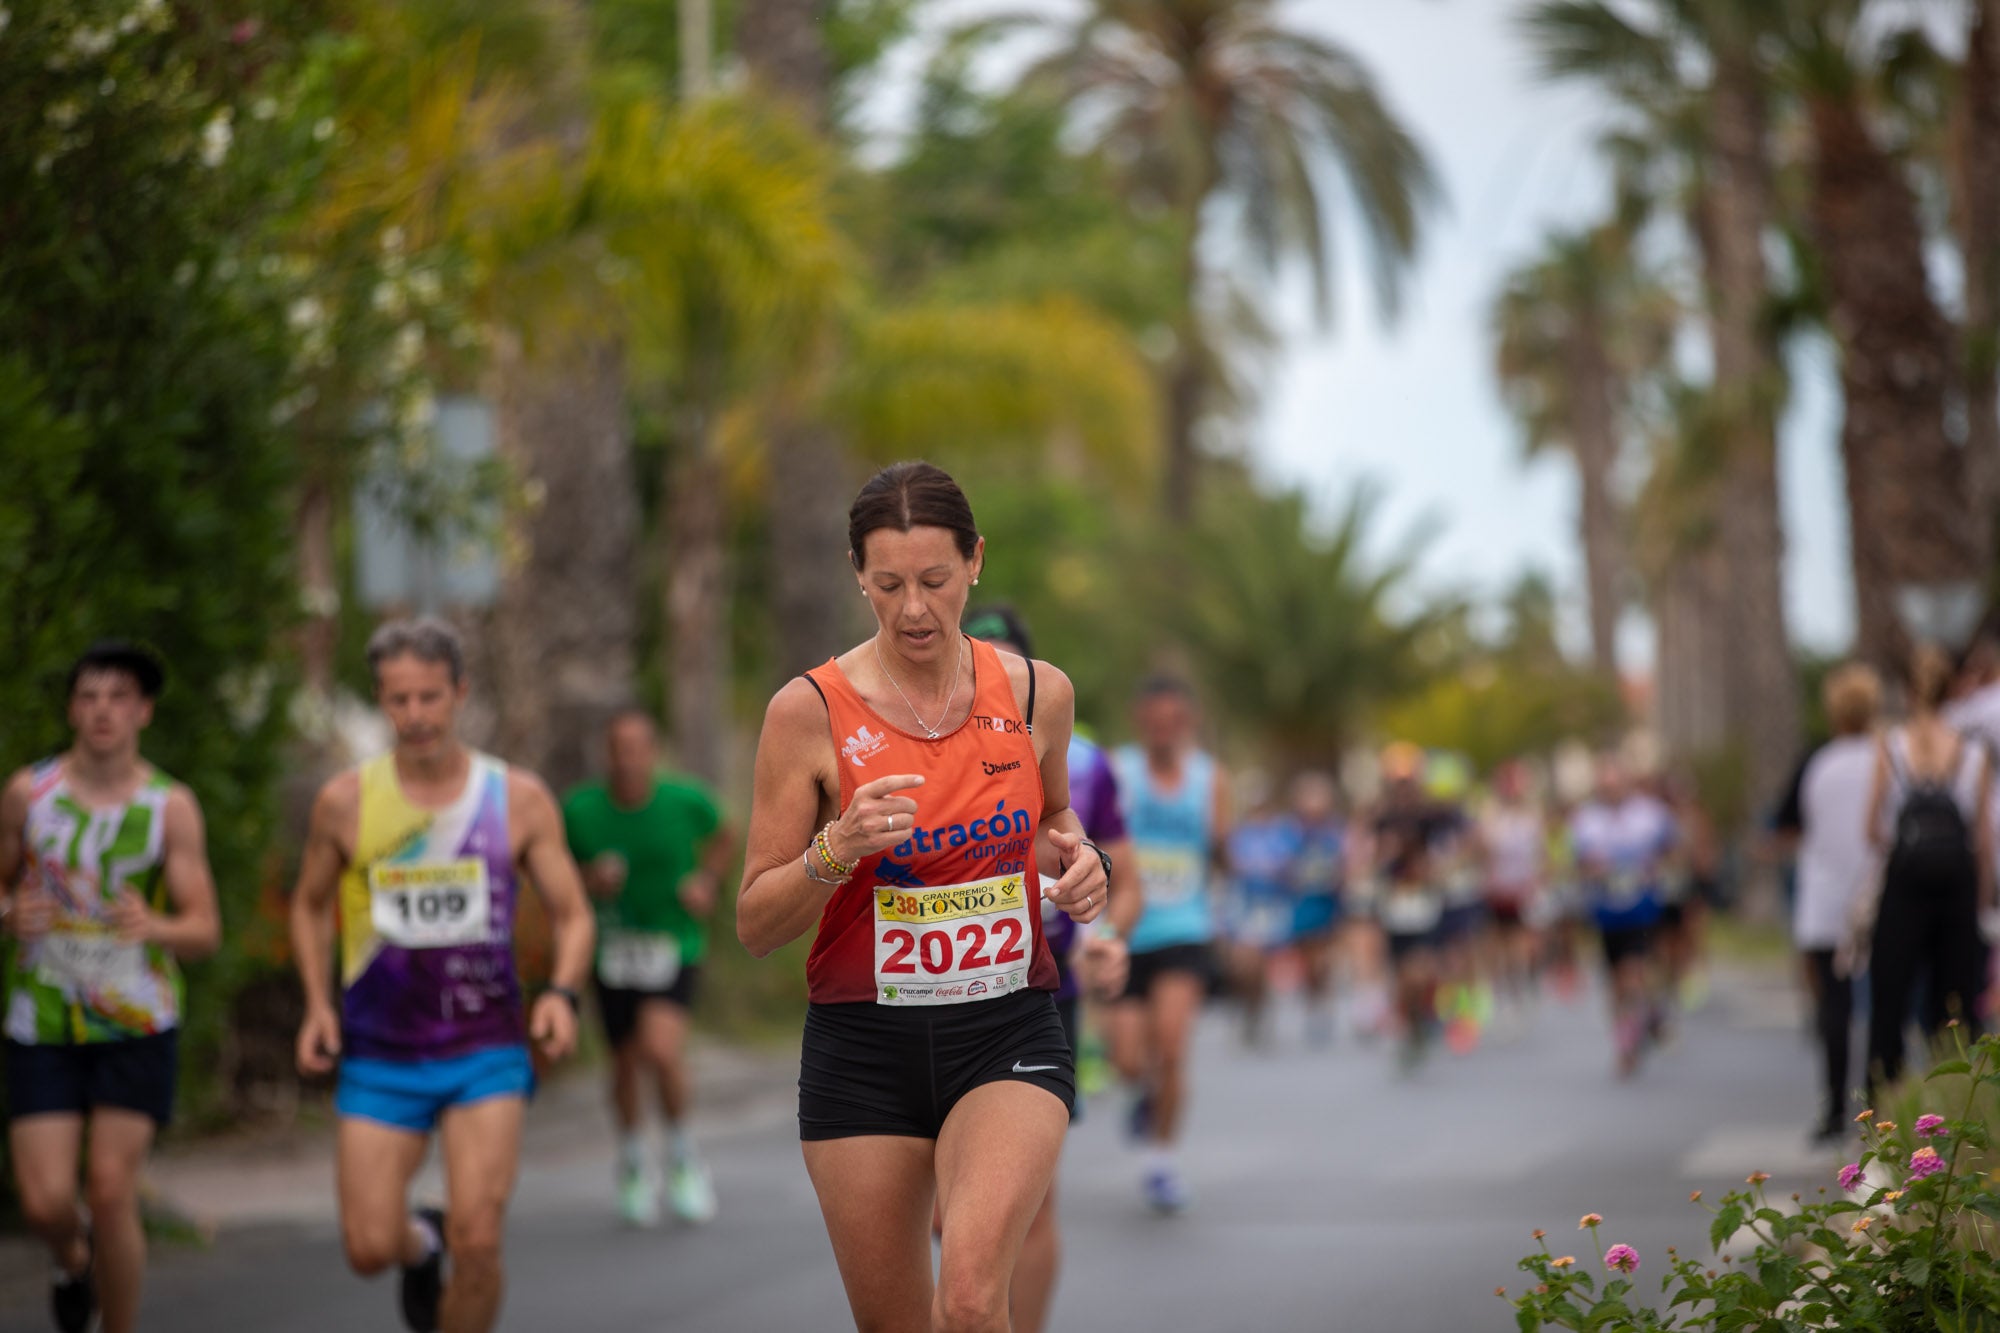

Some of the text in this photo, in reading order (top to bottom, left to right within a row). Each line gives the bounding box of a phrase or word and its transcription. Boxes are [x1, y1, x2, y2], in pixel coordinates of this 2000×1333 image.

[973, 715, 1023, 734] TRACK
[893, 800, 1031, 858] atracón
[963, 837, 1030, 861] running
[398, 888, 467, 923] 109
[896, 895, 919, 915] 38
[919, 892, 996, 917] FONDO
[922, 892, 951, 902] GRAN
[953, 885, 988, 899] PREMIO
[880, 917, 1025, 975] 2022
[899, 987, 934, 996] Cruzcampo
